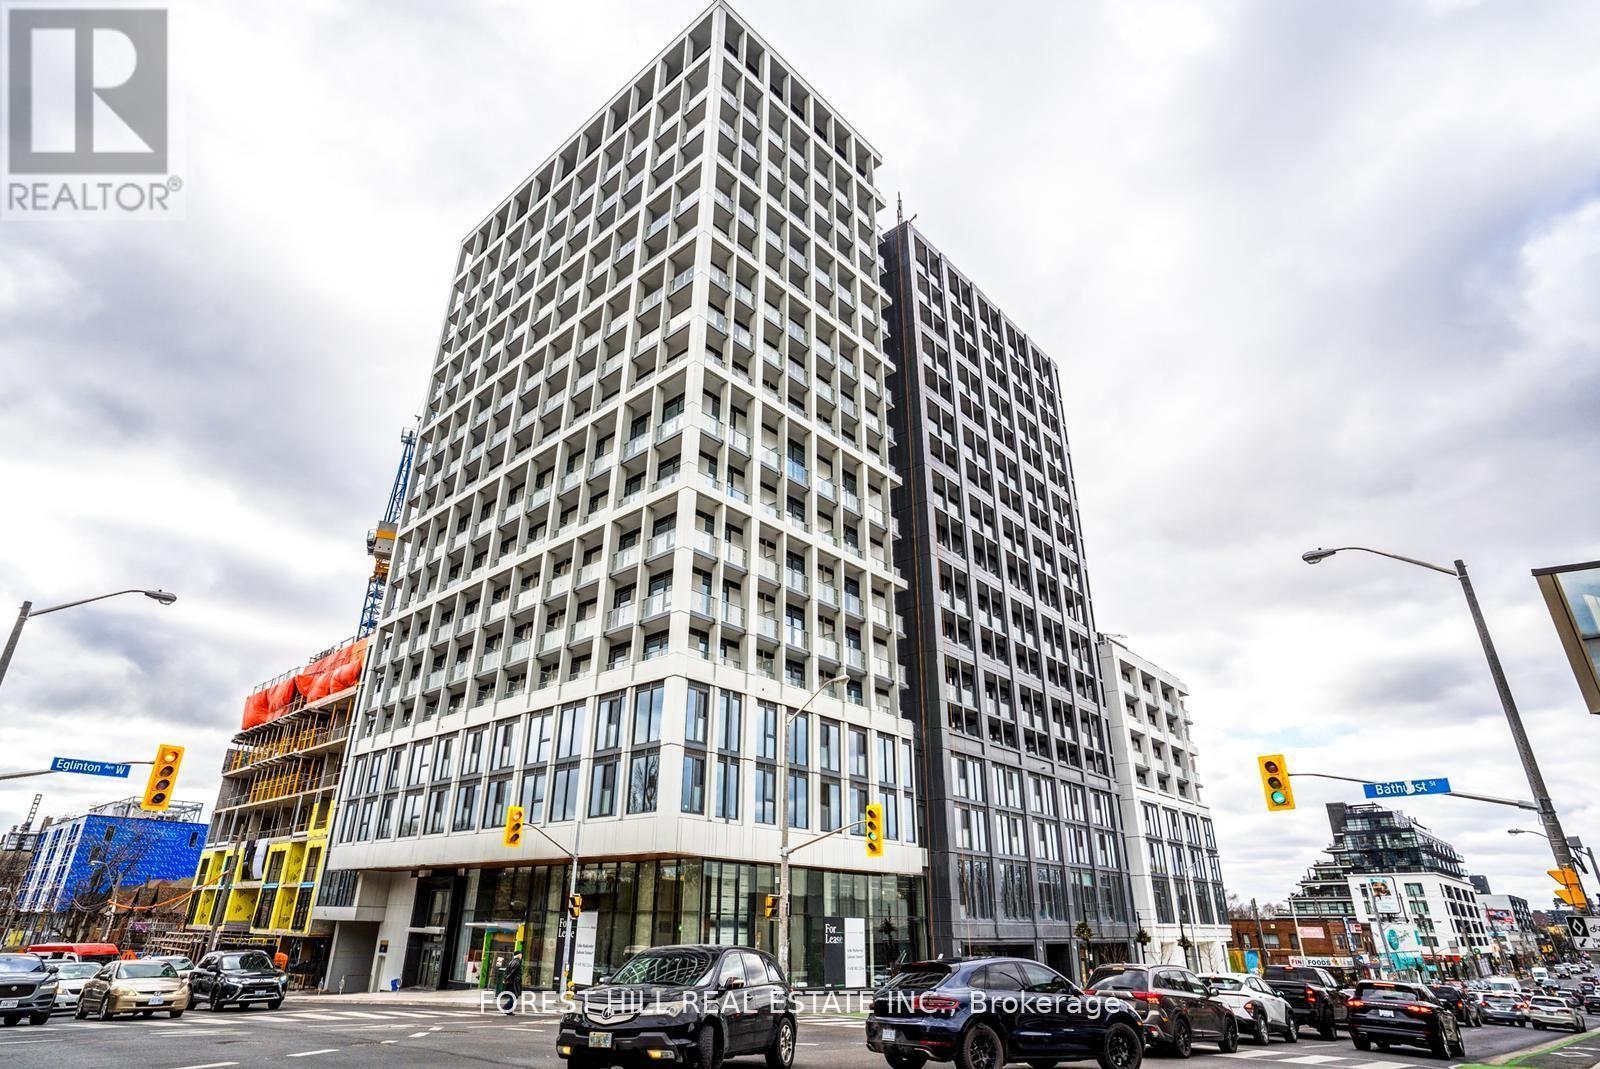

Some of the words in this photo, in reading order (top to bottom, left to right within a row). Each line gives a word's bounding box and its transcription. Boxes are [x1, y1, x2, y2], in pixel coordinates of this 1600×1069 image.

[56, 758, 101, 772] Eglinton
[115, 764, 126, 775] W
[1375, 781, 1428, 795] Bathust
[559, 918, 568, 928] Fo
[825, 924, 837, 934] For
[825, 934, 843, 944] Lease
